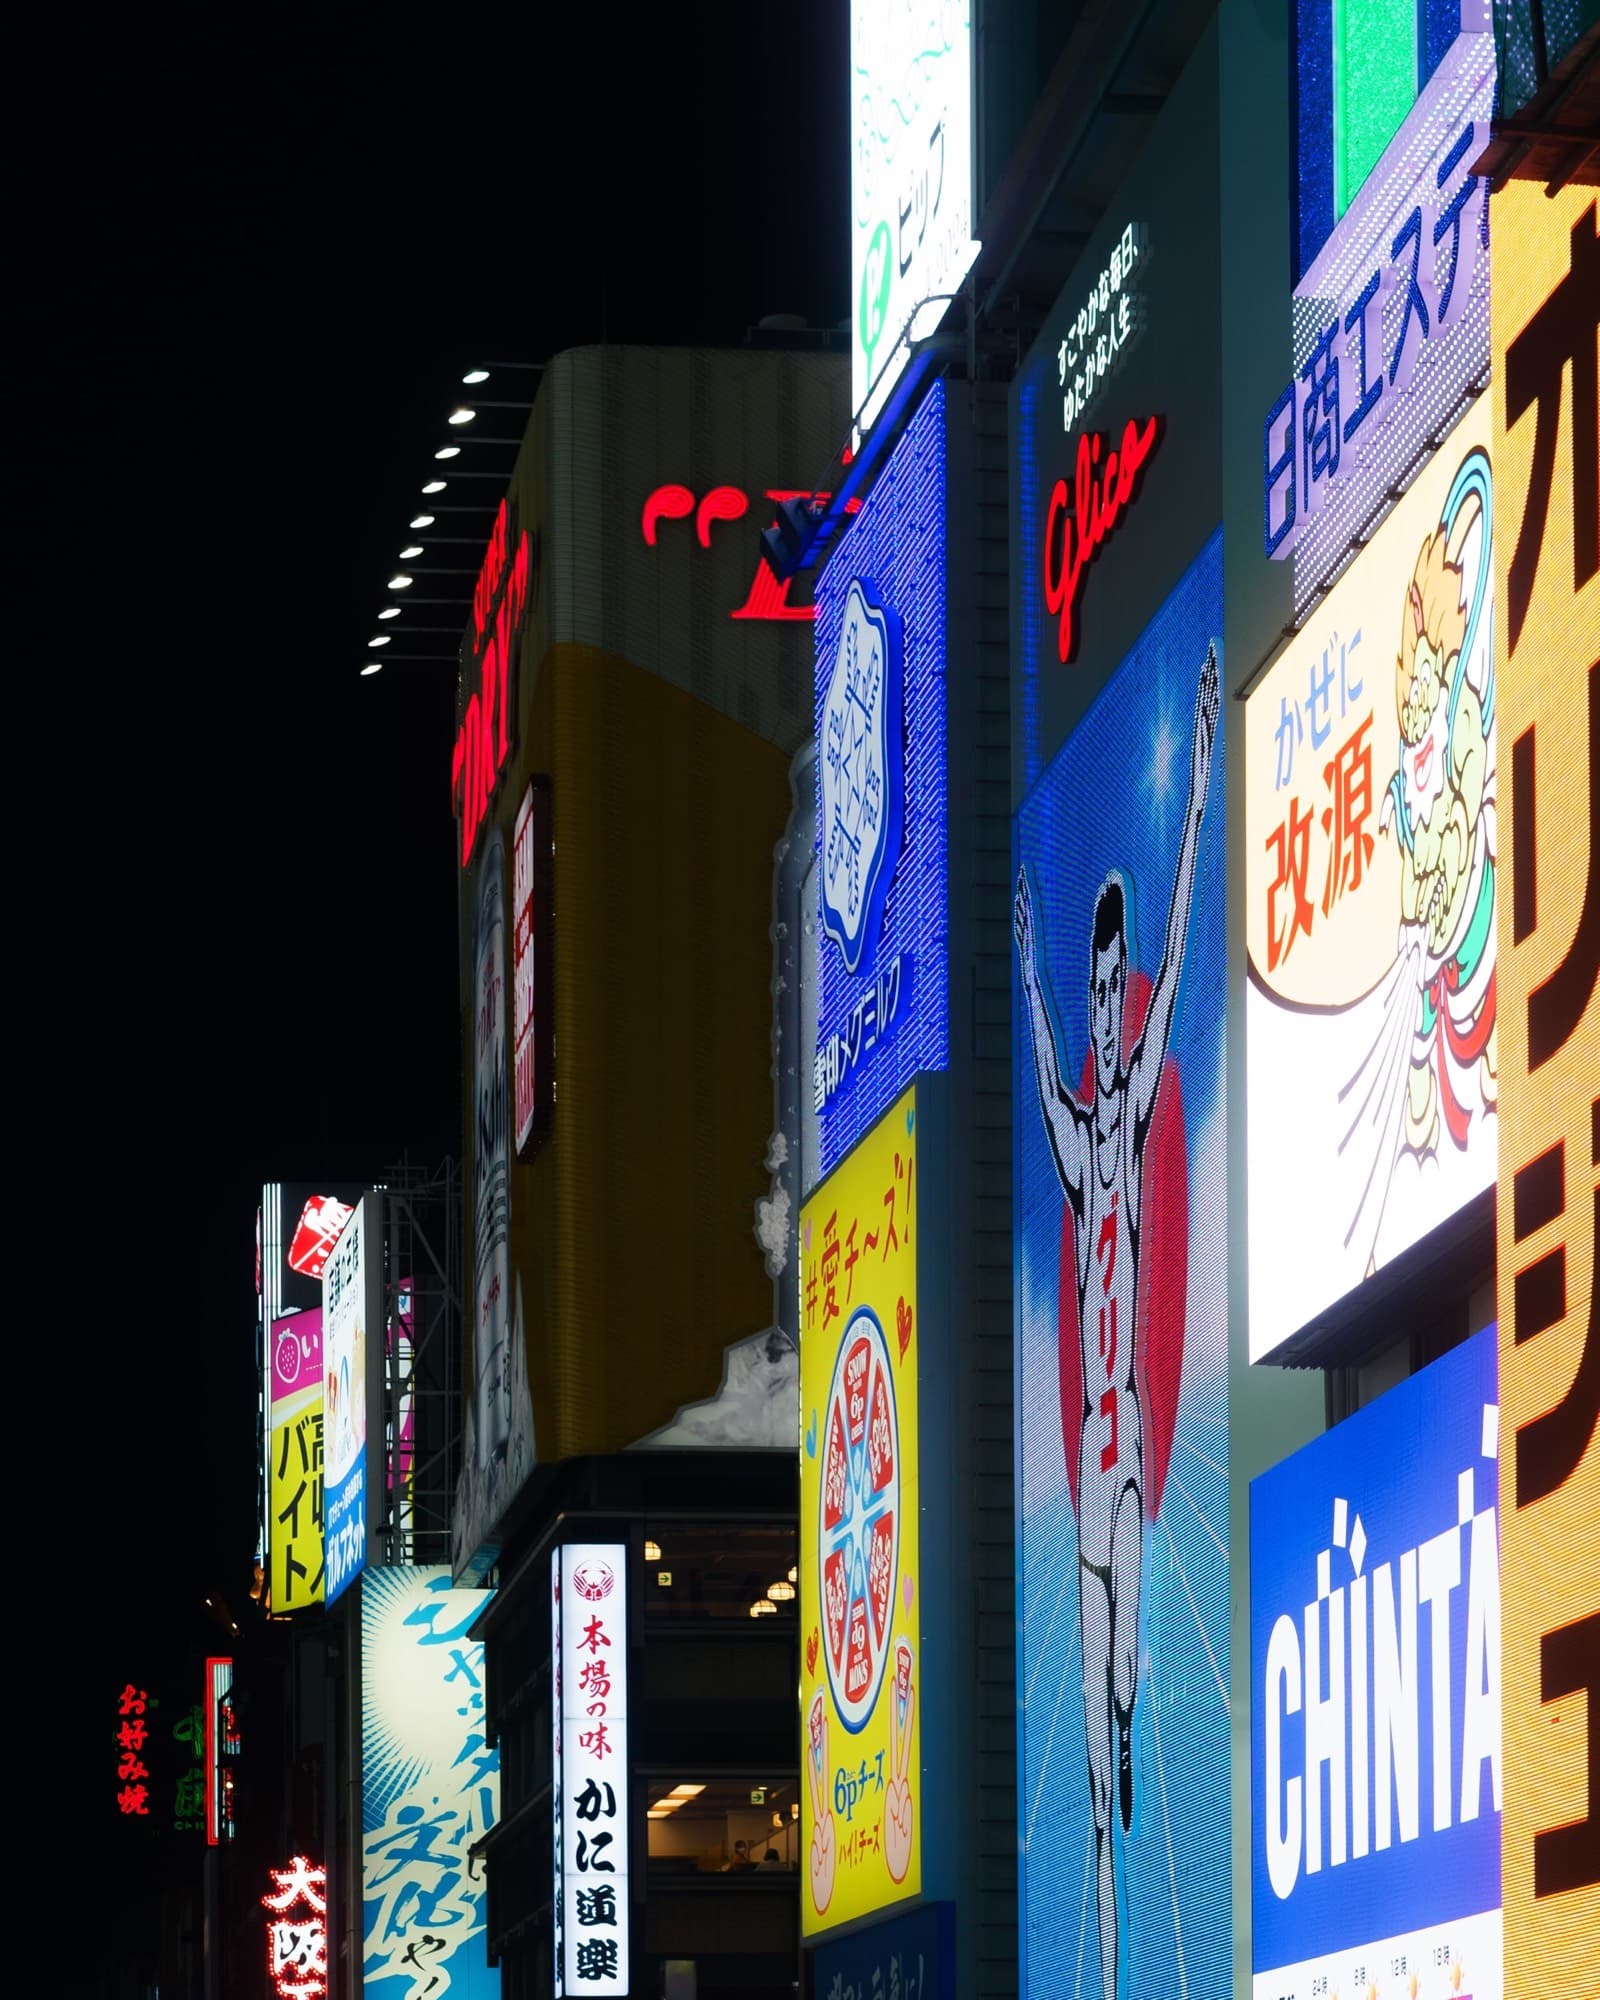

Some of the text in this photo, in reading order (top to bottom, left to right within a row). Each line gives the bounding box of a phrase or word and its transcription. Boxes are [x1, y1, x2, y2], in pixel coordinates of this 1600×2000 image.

[1057, 222, 1139, 387] すこやかな毎日、
[1063, 292, 1132, 433] ゆたかな人生
[1265, 121, 1490, 559] 日商エステ
[1045, 416, 1158, 664] Glico
[1274, 627, 1365, 793] かぜに
[1265, 707, 1376, 974] 改源
[812, 955, 900, 1116] 雪印メグミルク
[1097, 1190, 1119, 1474] グリコ
[278, 1416, 309, 1602] バイト
[117, 1684, 149, 1815] お好み焼
[576, 1613, 613, 1762] 本場の味
